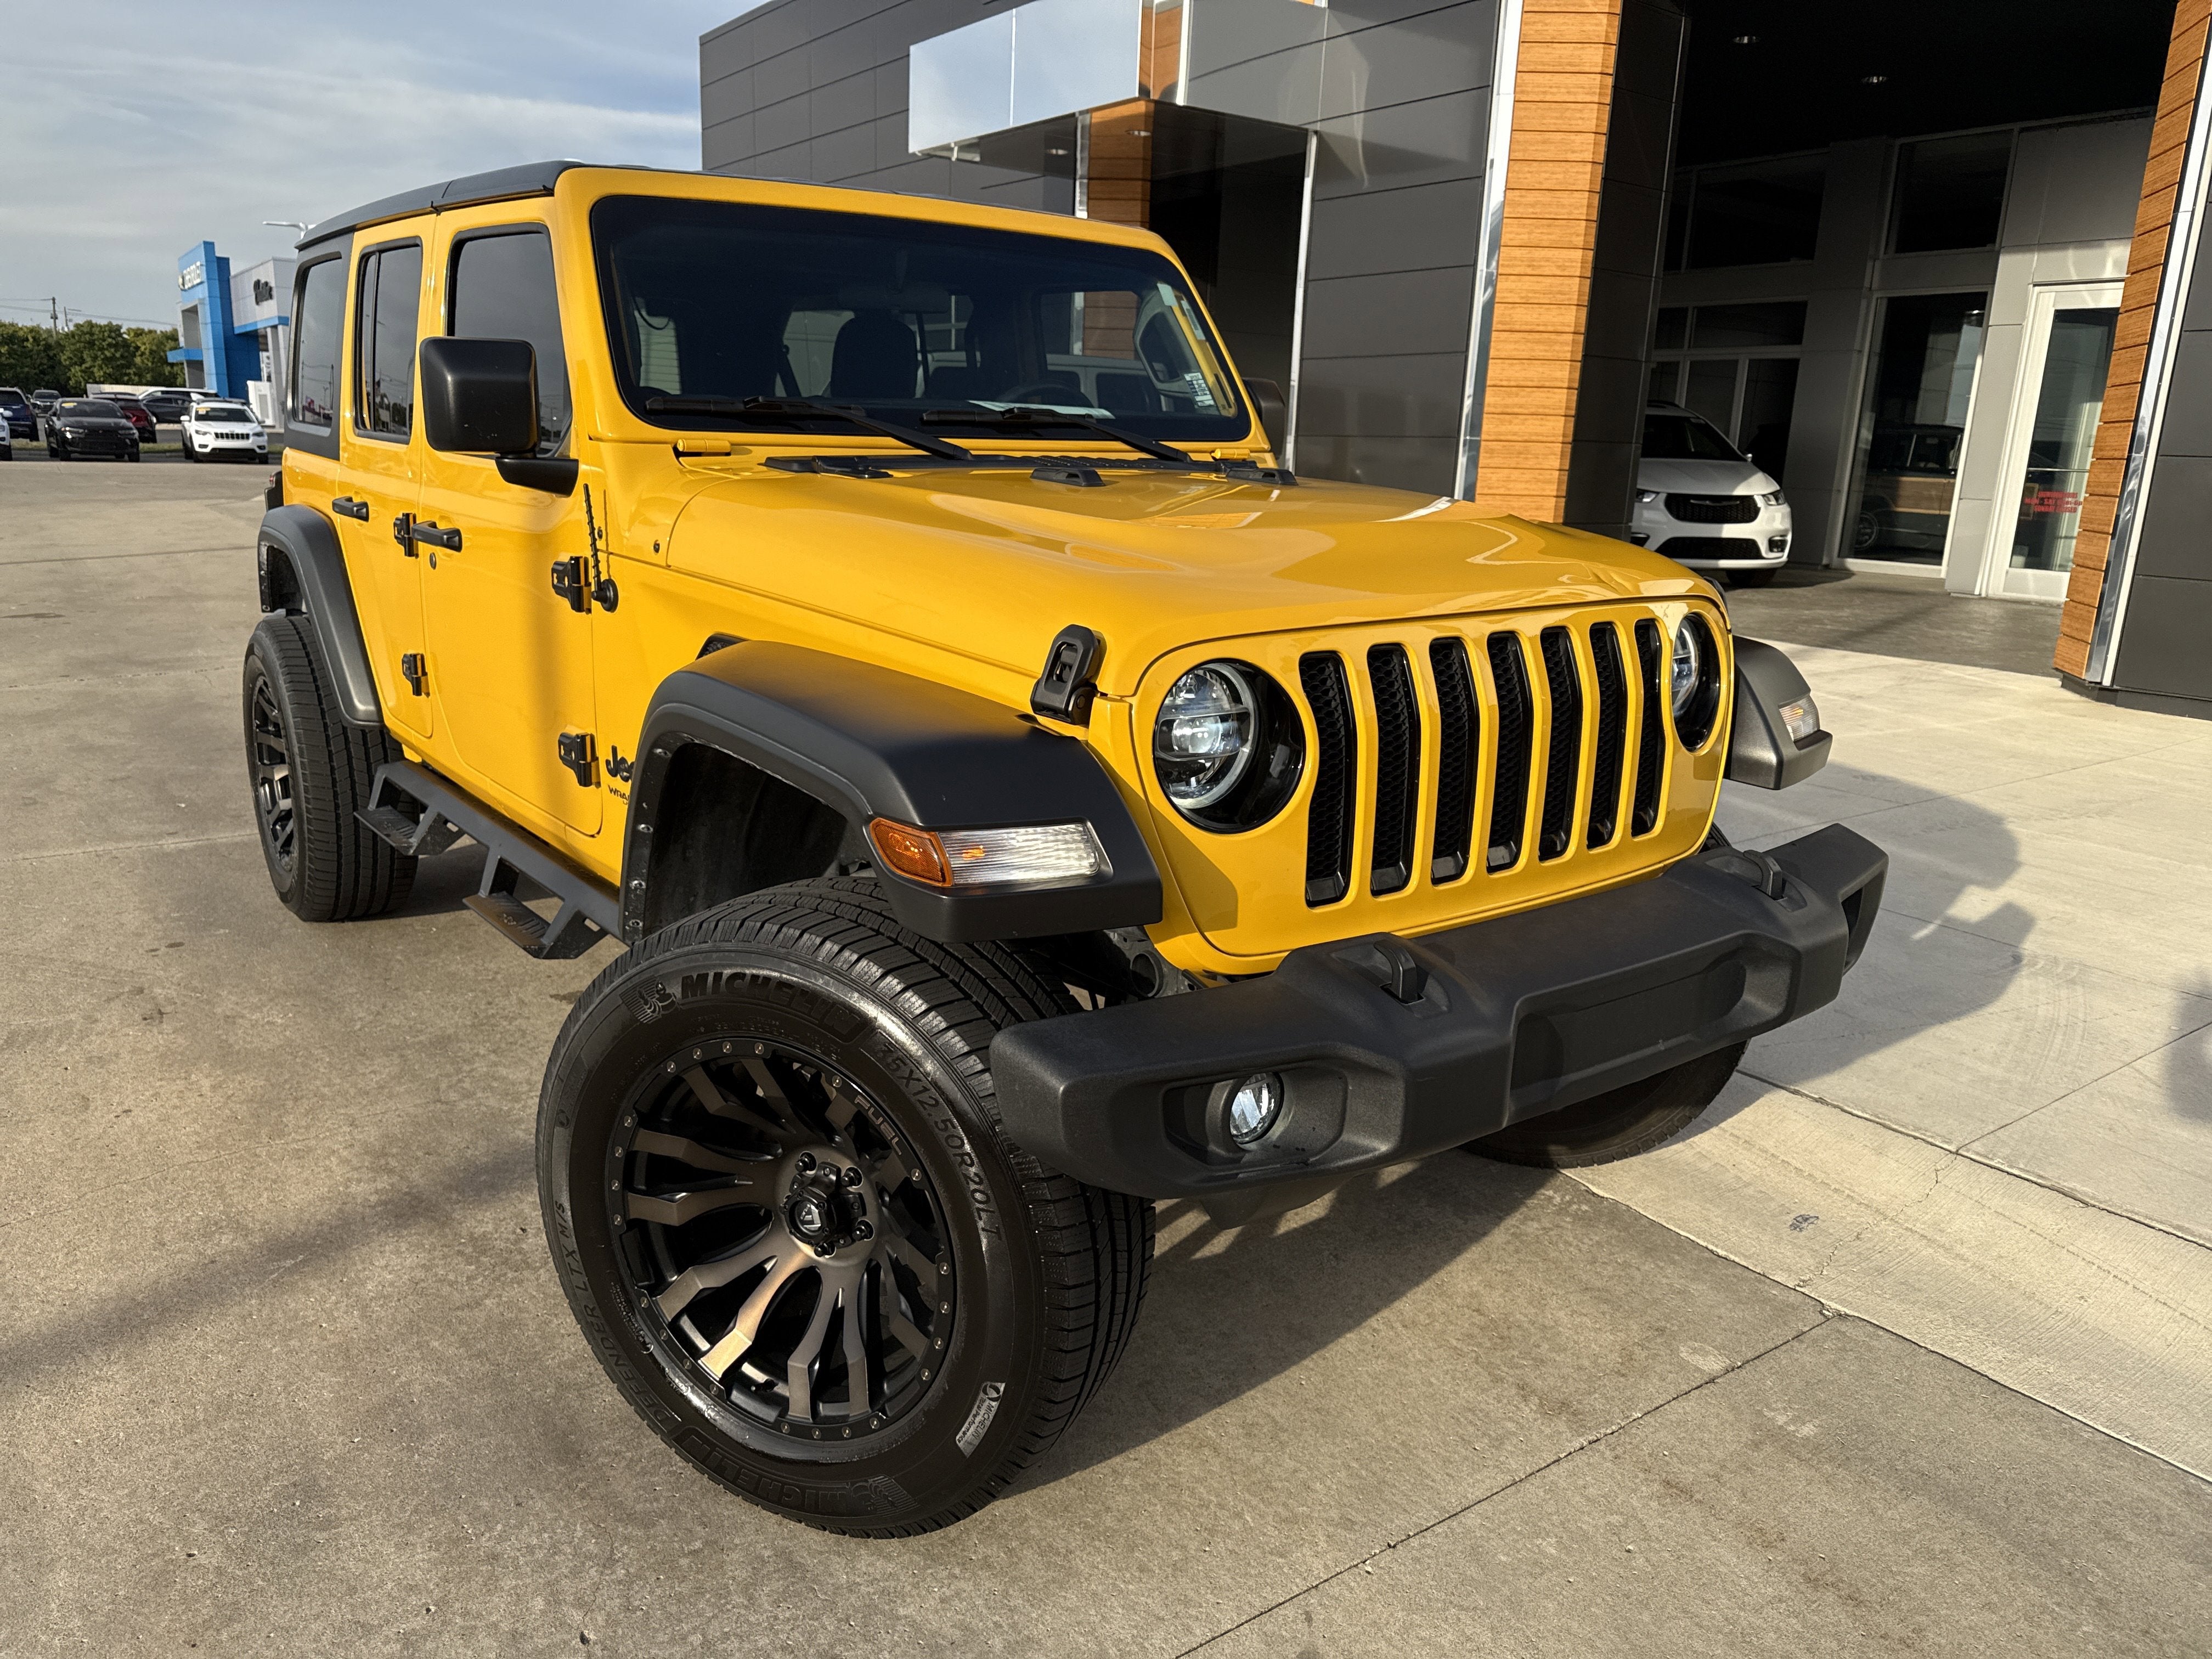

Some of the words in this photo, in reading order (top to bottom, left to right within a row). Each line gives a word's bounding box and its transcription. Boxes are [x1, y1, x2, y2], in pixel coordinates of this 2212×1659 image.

[681, 972, 861, 1035] MICHELIN
[854, 1094, 902, 1156] FUEL
[555, 1200, 570, 1239] M/S
[562, 1243, 589, 1293] LTX
[584, 1304, 672, 1421] DEFENDER
[972, 1402, 995, 1440] MICHELIN
[680, 1434, 848, 1512] MICHELIN
